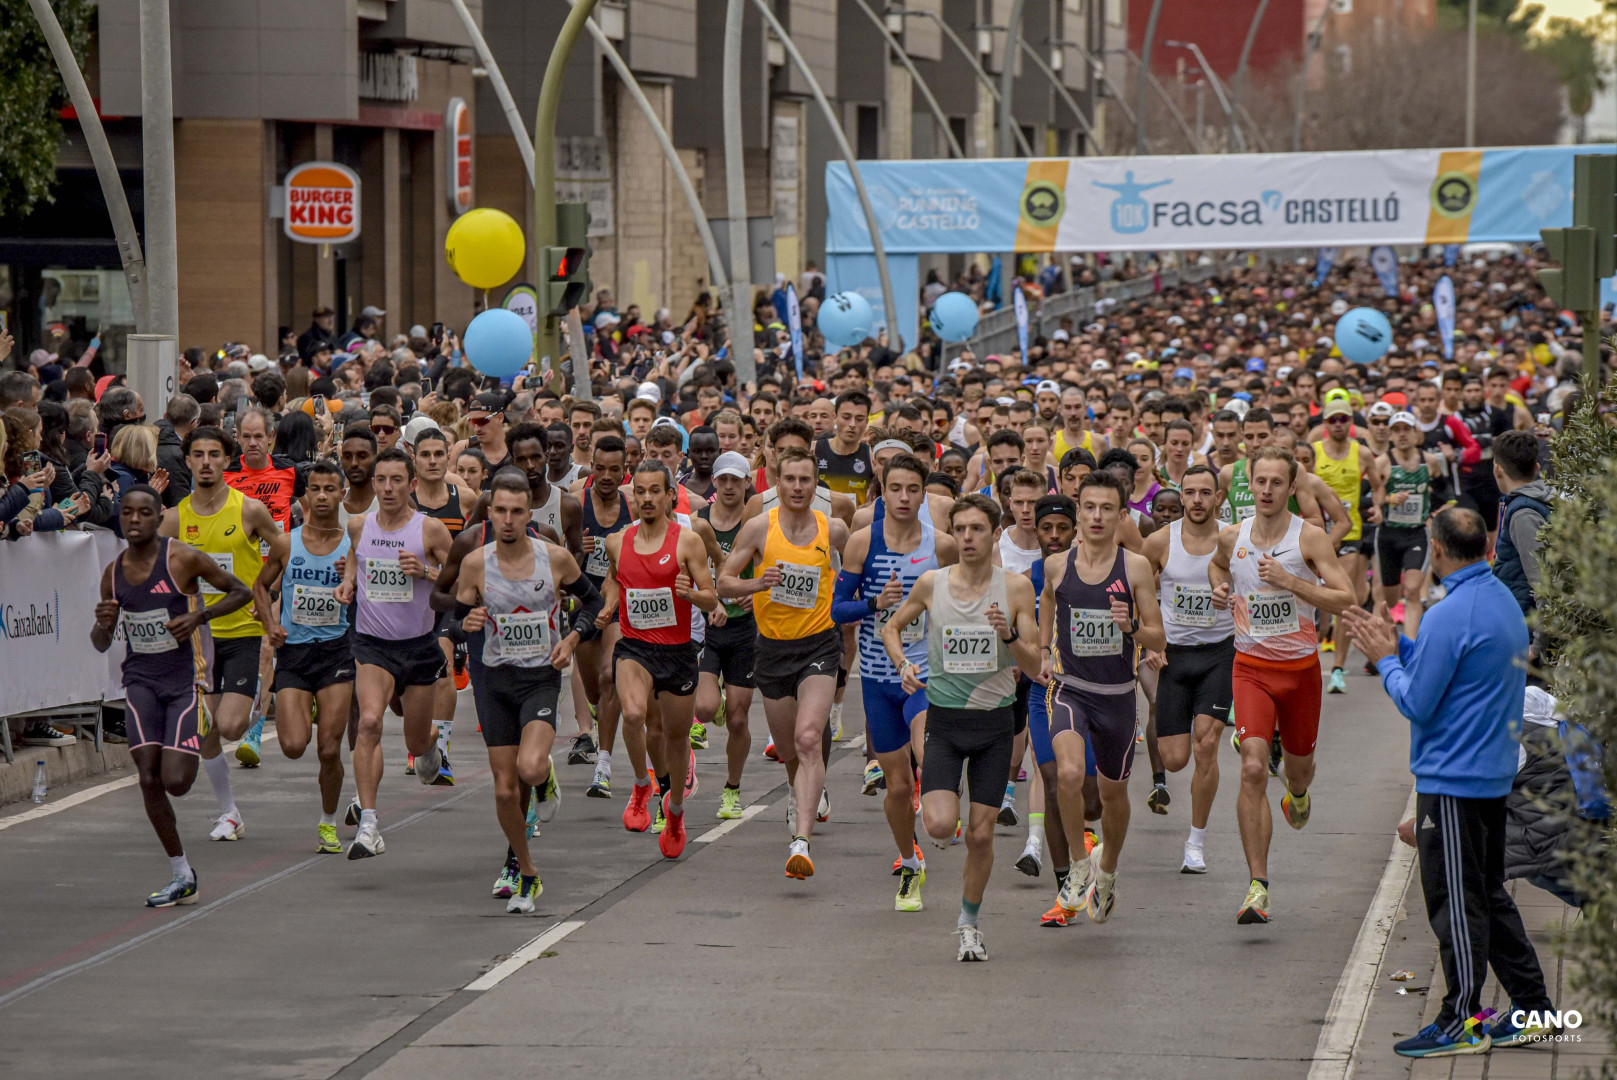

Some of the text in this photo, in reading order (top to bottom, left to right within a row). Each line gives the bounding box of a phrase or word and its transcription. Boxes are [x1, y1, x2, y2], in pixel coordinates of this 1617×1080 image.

[290, 189, 353, 204] BURGER
[898, 196, 978, 213] RUNNING
[290, 204, 353, 225] KING
[1116, 204, 1145, 228] 10K
[1284, 192, 1399, 224] CASTELLÓ
[255, 483, 280, 495] RUN
[371, 539, 405, 548] KIPRUN
[292, 566, 341, 586] nerja
[370, 569, 407, 586] 2033
[780, 572, 814, 592] 2029
[785, 588, 803, 597] MOEN
[297, 596, 335, 612] 2026
[631, 598, 668, 614] 2008
[1177, 594, 1212, 610] 2127
[1252, 601, 1291, 619] 2009
[6, 602, 54, 639] CaixaBank
[129, 621, 166, 637] 2003
[503, 623, 542, 641] 2001
[1076, 621, 1114, 638] 2011
[508, 639, 541, 647] WANDERS
[948, 638, 991, 654] 2072
